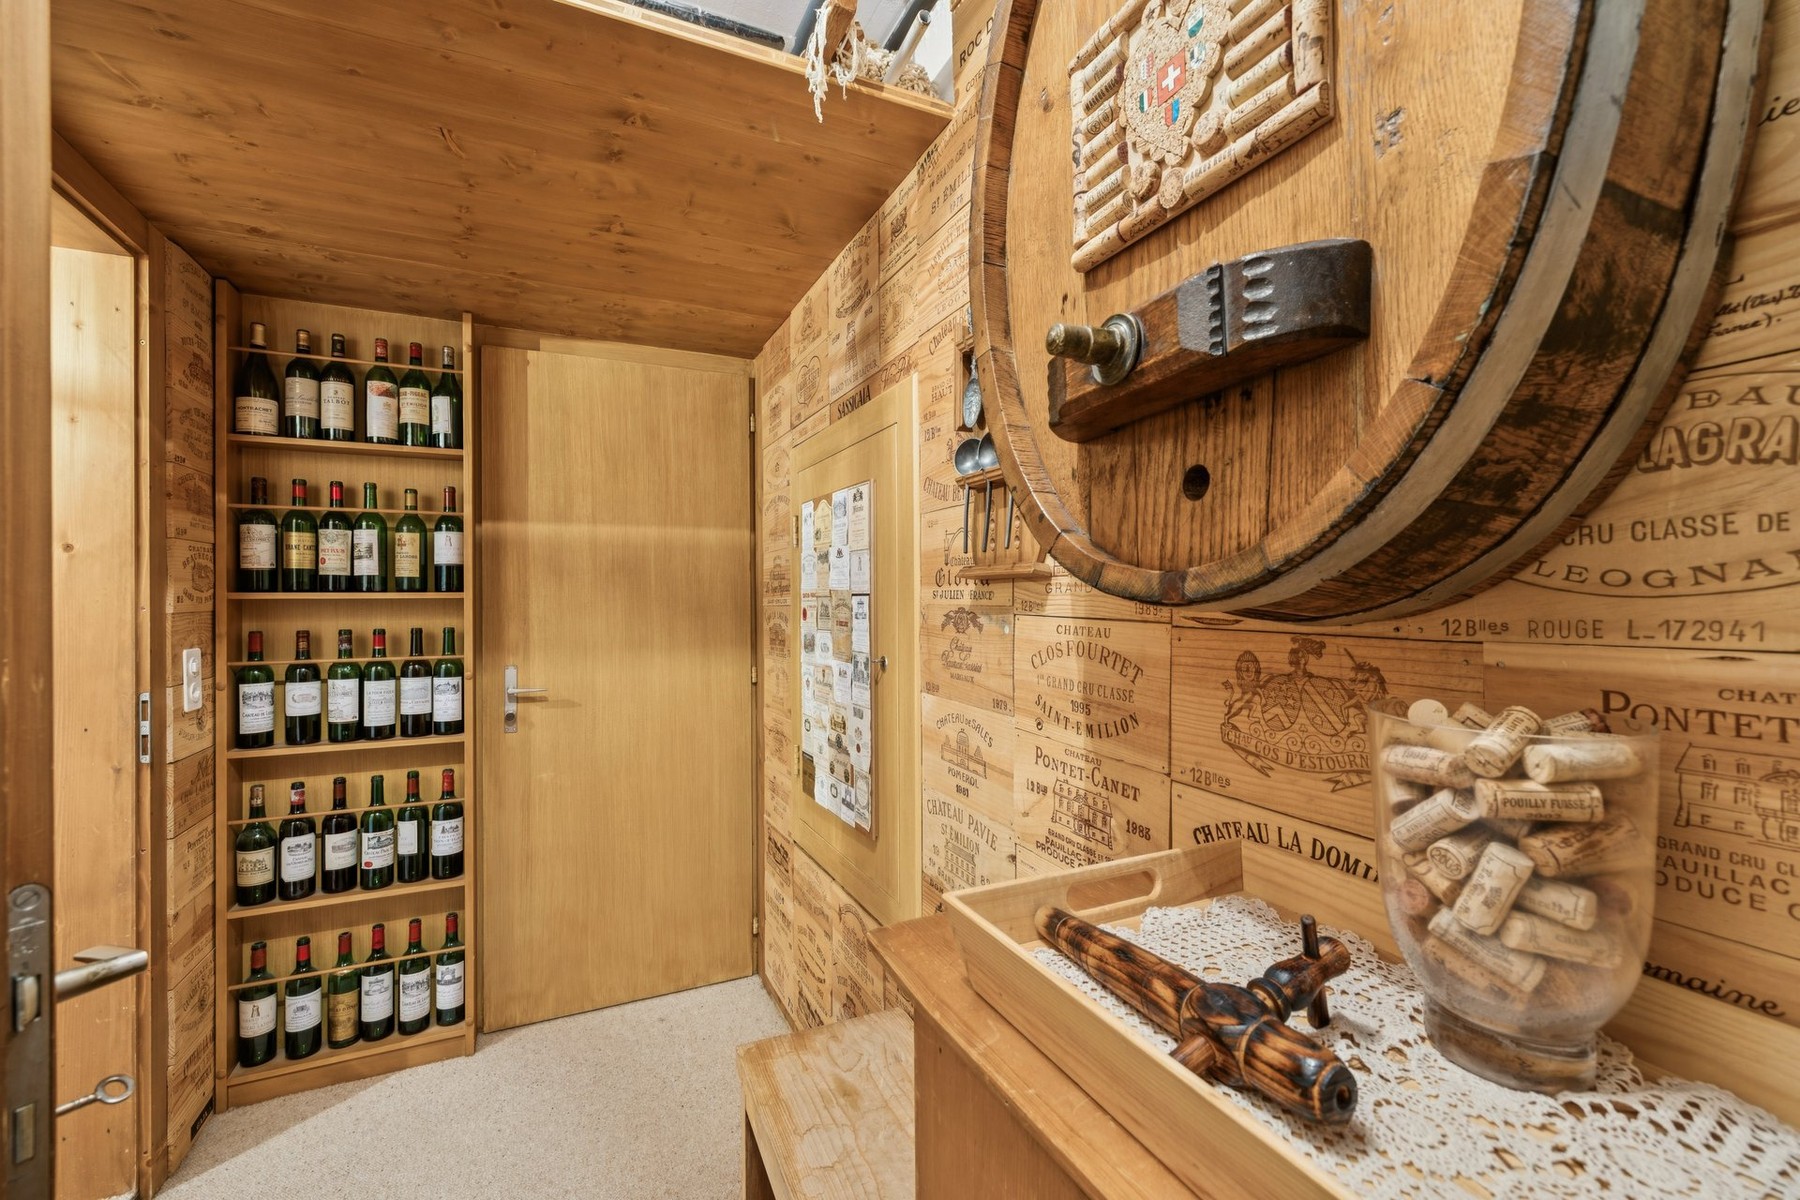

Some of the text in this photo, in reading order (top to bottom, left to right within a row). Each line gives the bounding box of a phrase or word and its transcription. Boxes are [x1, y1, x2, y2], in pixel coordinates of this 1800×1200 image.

[958, 30, 983, 68] ROC
[931, 384, 953, 403] HAUT
[1560, 511, 1791, 547] CRU CLASSE DE
[1044, 581, 1093, 595] GRAND
[1055, 624, 1112, 640] CHATEAU
[1527, 618, 1605, 640] ROUGE
[1030, 639, 1144, 686] CLOS FOURTET
[1046, 675, 1075, 692] GRAND
[1076, 681, 1095, 696] CRU
[1097, 684, 1135, 704] CLASSE
[1070, 699, 1092, 717] 1995
[936, 712, 966, 730] CHATEAU
[971, 718, 995, 749] SALES
[1064, 748, 1103, 767] CHATEAU
[1253, 741, 1281, 761] COS
[947, 766, 980, 790] POMEROL
[1034, 745, 1141, 803] PONTET-CANET
[1501, 796, 1547, 810] POUILLY
[967, 814, 998, 852] PAVIE
[1192, 820, 1270, 846] CHATEAU
[1277, 825, 1303, 854] LA
[1035, 840, 1076, 869] PRODUCE
[1656, 835, 1721, 861] GRAND
[1728, 851, 1767, 872] CRU
[1655, 854, 1791, 895] AUILLAC
